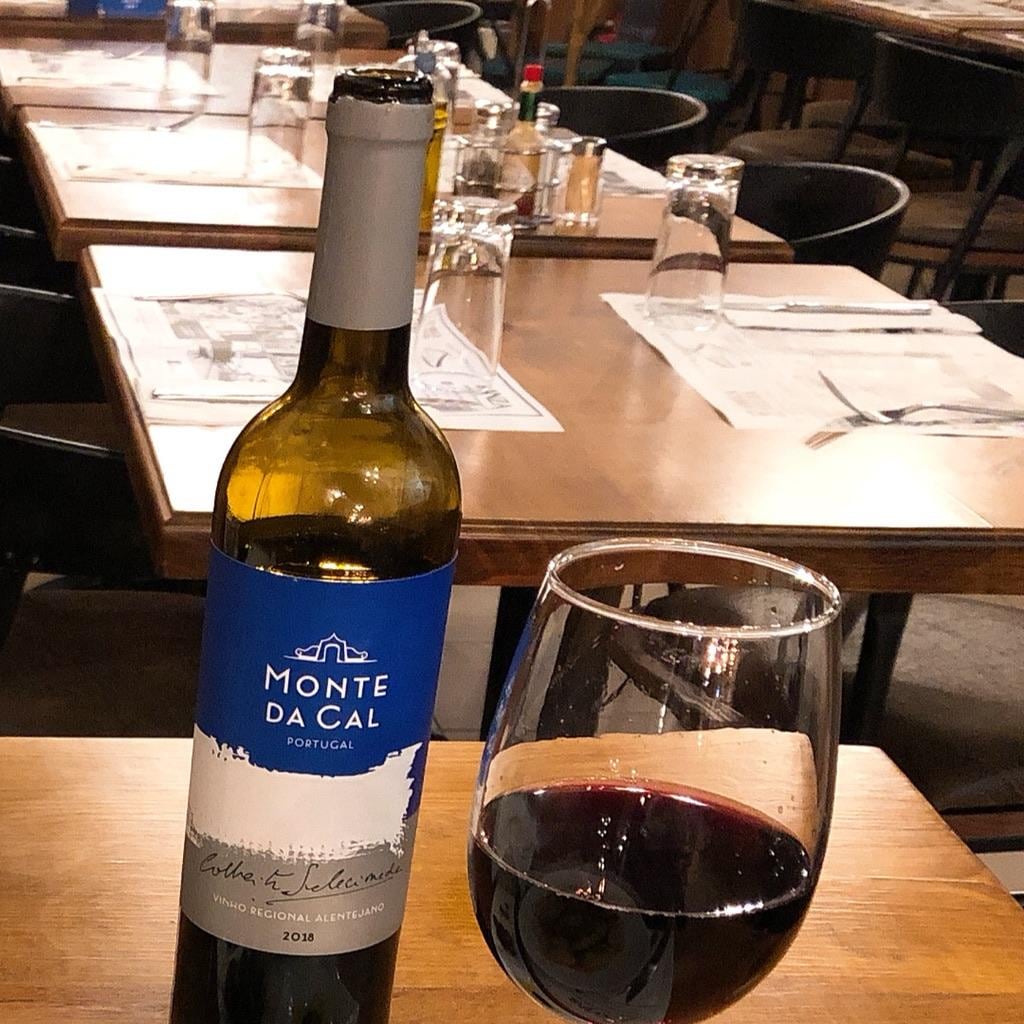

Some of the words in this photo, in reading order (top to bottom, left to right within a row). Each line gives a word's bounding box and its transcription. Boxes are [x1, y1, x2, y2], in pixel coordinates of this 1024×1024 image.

[264, 663, 389, 698] MONTE
[265, 701, 306, 728] DA
[316, 704, 380, 730] CAL
[287, 737, 355, 750] PORTUGAL
[211, 892, 247, 914] VINHO
[249, 906, 312, 923] REGIONAL
[315, 902, 386, 923] ALENTEJANO
[282, 931, 315, 943] 2018
